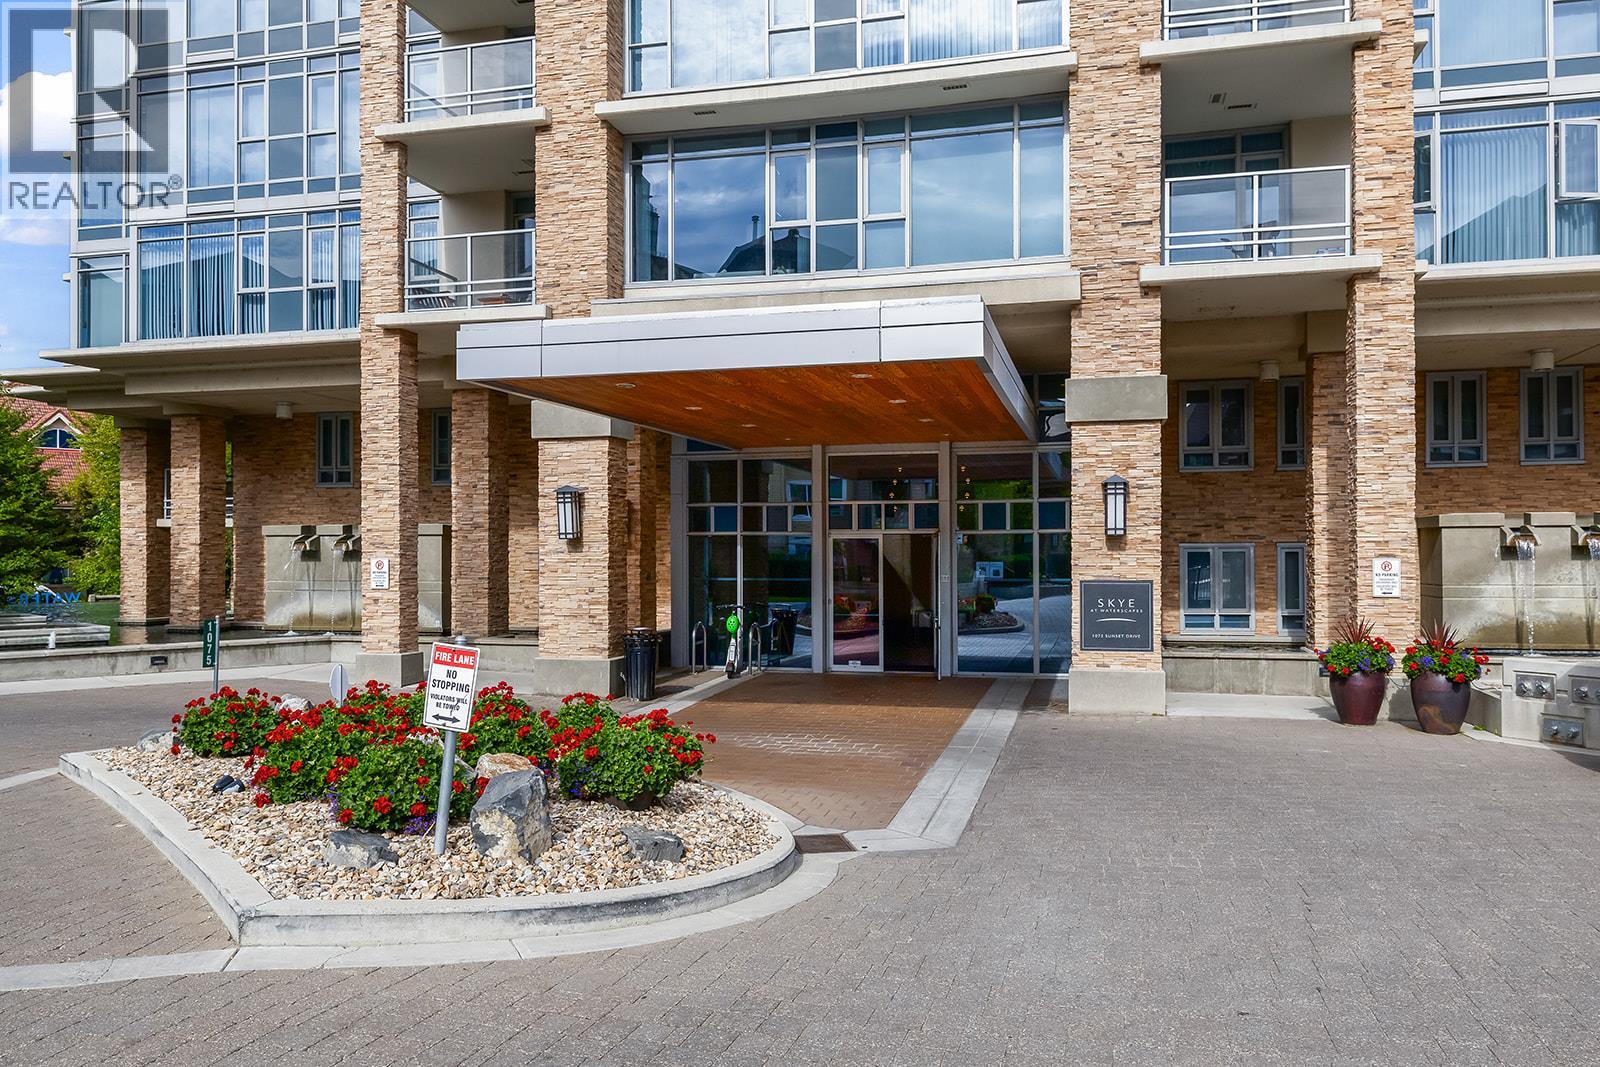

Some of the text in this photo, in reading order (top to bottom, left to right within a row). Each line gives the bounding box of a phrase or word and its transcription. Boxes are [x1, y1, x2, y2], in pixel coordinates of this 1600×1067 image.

[1097, 598, 1135, 608] SKYE
[435, 651, 474, 665] FIRE LANE
[446, 669, 457, 679] NO
[431, 678, 470, 693] STOPPING
[430, 693, 455, 702] VIOLATORS
